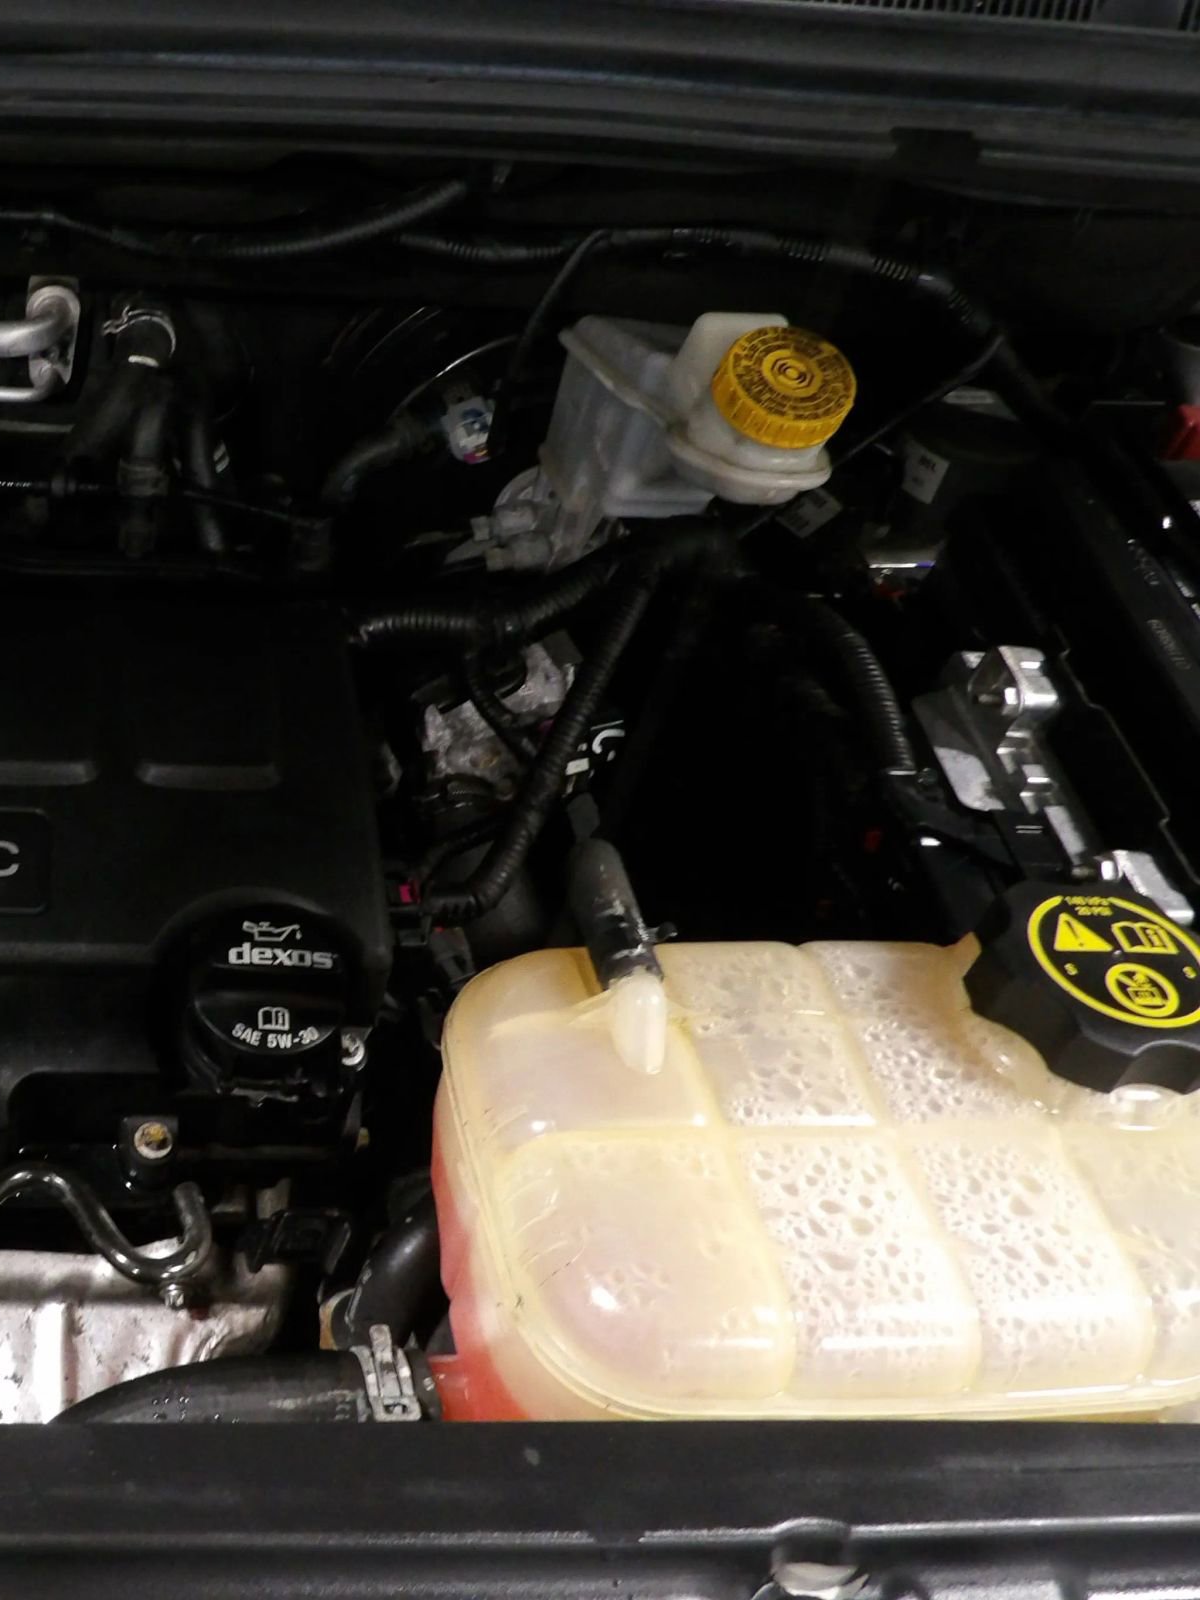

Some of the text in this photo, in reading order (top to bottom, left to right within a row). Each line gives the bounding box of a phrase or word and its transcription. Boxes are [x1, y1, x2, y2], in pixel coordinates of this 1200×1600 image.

[228, 942, 334, 969] dexos
[231, 1022, 319, 1049] SAE 5W-30
